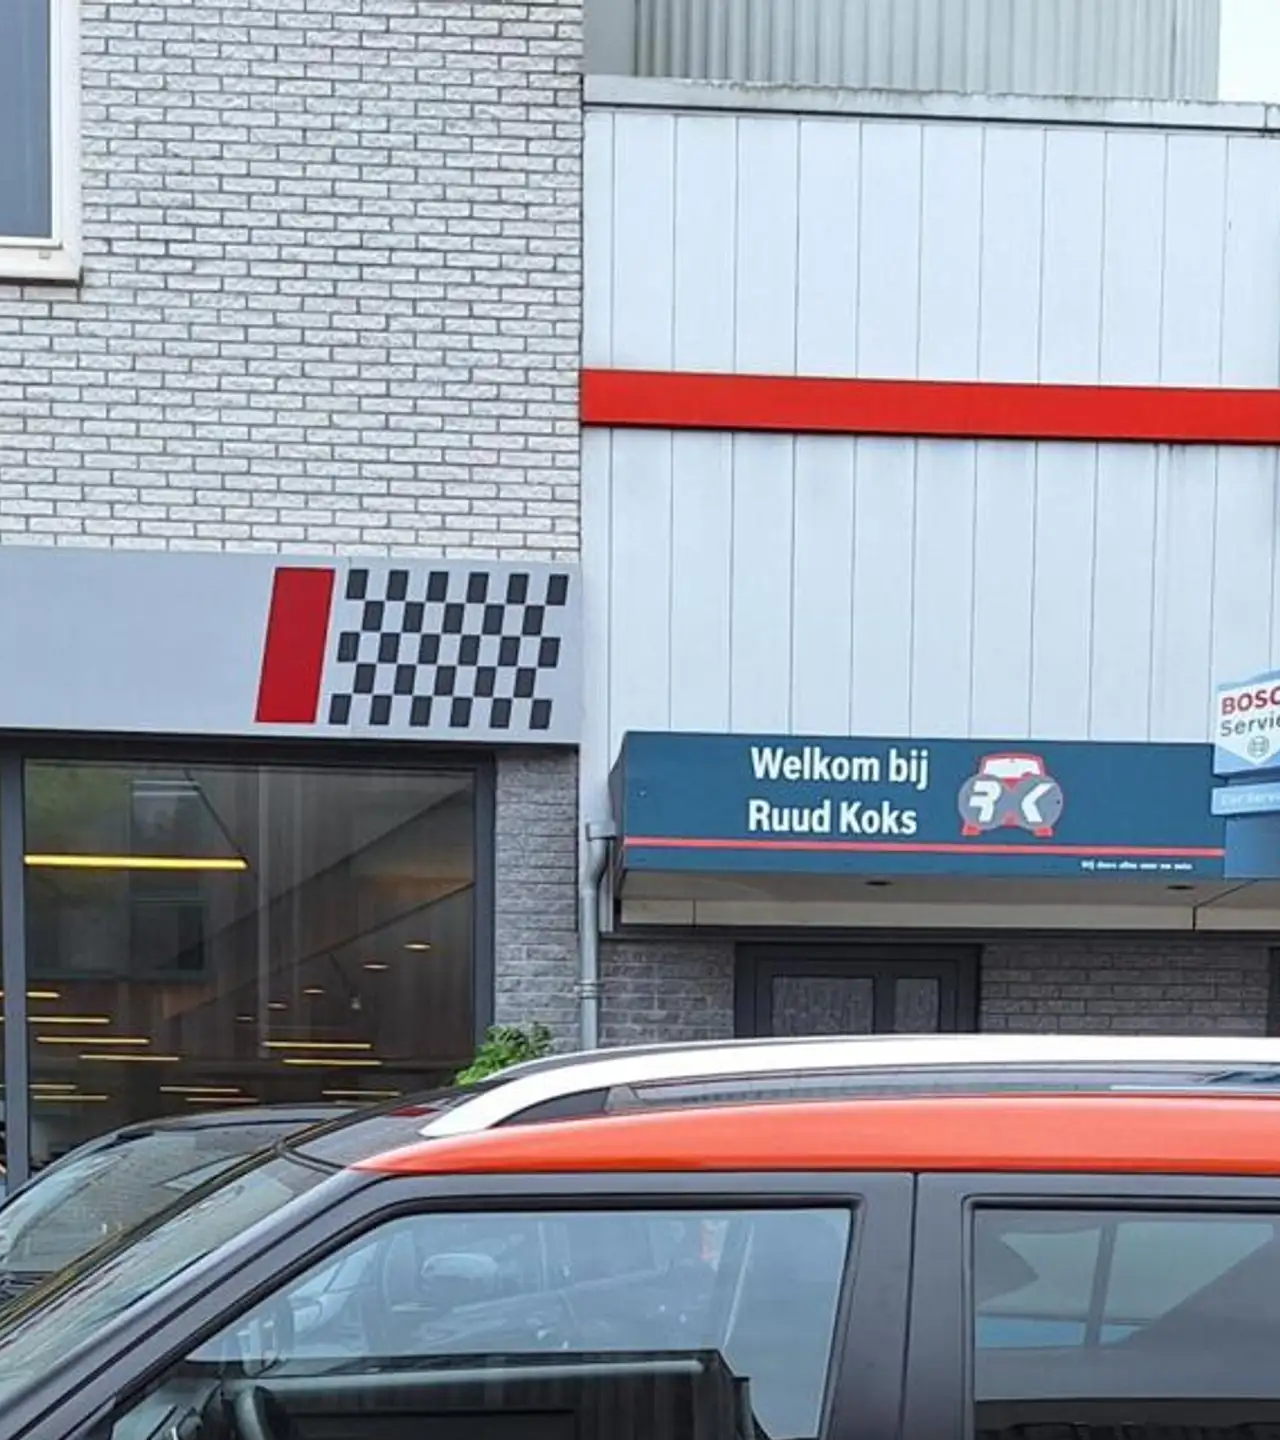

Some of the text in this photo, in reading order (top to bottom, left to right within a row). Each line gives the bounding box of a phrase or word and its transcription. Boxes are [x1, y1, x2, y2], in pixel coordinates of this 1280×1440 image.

[750, 745, 929, 790] Welkom bij
[747, 798, 917, 836] Ruud Koks
